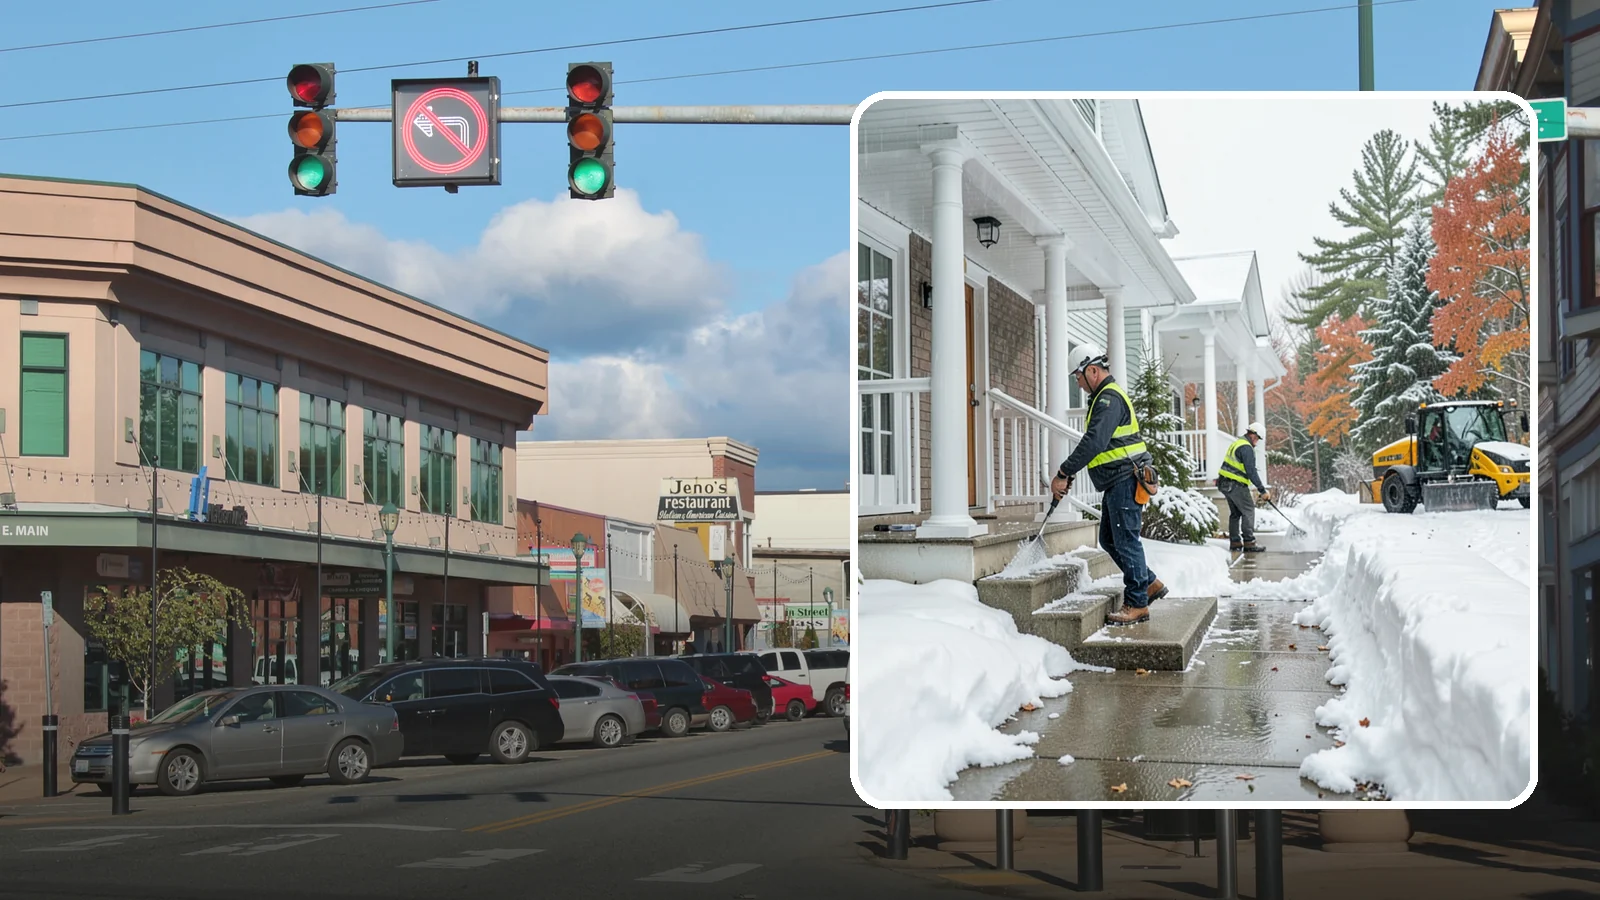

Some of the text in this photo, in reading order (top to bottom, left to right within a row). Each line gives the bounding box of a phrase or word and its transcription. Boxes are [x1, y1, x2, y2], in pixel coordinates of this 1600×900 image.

[670, 480, 727, 494] Jeno's
[665, 496, 731, 509] restaurant
[686, 509, 714, 519] American
[715, 509, 737, 519] Cuisine
[2, 525, 49, 536] E. MAIN
[797, 607, 828, 617] Street
